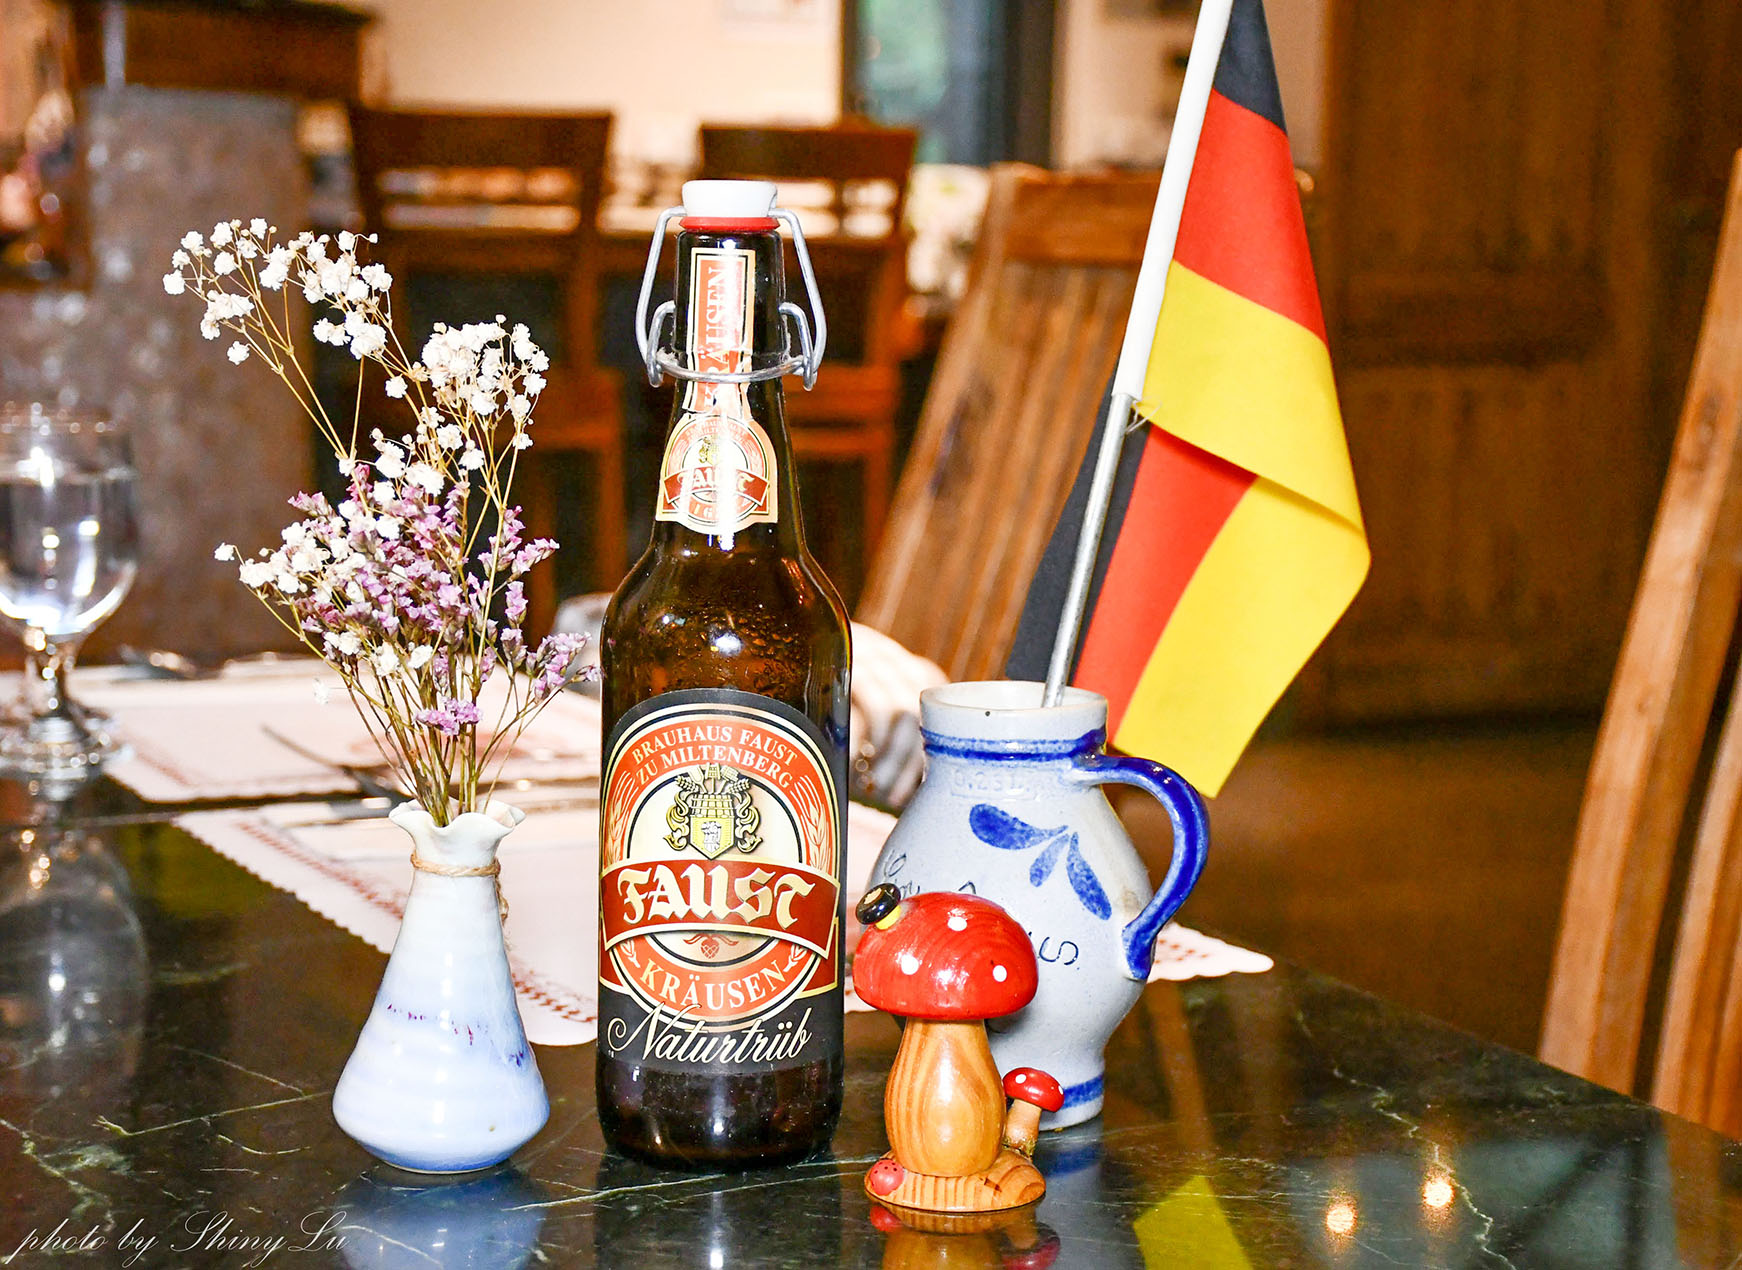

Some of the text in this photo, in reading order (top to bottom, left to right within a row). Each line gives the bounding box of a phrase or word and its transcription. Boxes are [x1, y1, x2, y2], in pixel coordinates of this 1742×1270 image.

[632, 724, 799, 765] BRAUHAUS FAUST
[635, 744, 795, 790] ZU MILTENBERG
[617, 862, 817, 930] FAUST
[639, 957, 787, 1011] KRÄUSEN
[606, 1000, 813, 1065] Naturtrüb
